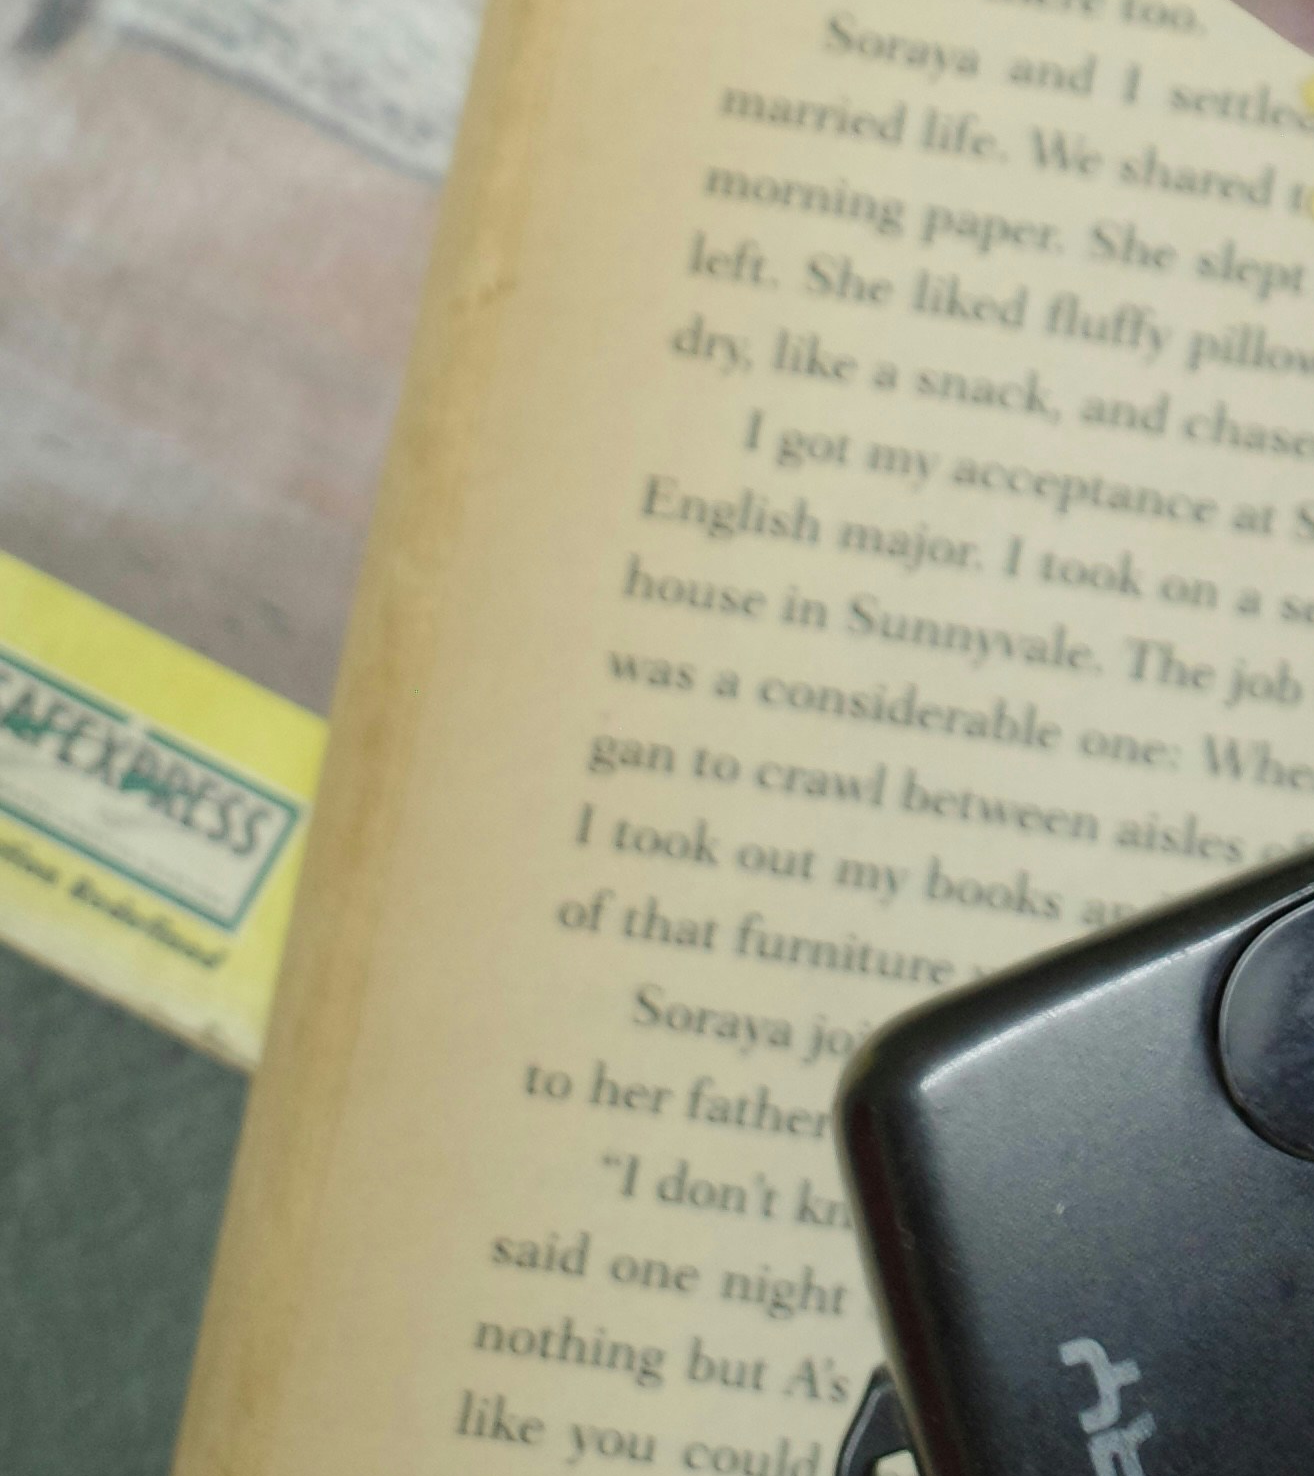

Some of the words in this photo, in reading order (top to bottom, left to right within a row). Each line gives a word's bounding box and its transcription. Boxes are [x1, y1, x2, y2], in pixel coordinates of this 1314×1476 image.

[702, 166, 904, 237] morning
[919, 203, 1062, 257] paper.
[1089, 223, 1176, 271] She
[1195, 240, 1305, 302] slept
[744, 409, 763, 451] I
[774, 431, 849, 468] got
[865, 444, 933, 488] my
[949, 459, 1217, 526] acceptance
[1230, 505, 1274, 536] at
[640, 475, 820, 545] English
[836, 520, 985, 572] major.
[1002, 535, 1023, 578] I
[1037, 552, 1141, 598] took
[1157, 577, 1218, 609] on
[491, 1232, 590, 1277] said
[608, 1256, 699, 1294] one
[720, 1266, 846, 1319] night
[472, 1317, 664, 1387] nothing
[686, 1337, 764, 1391] but
[786, 1356, 848, 1403] A's
[455, 1390, 544, 1445] like
[567, 1424, 656, 1464] you
